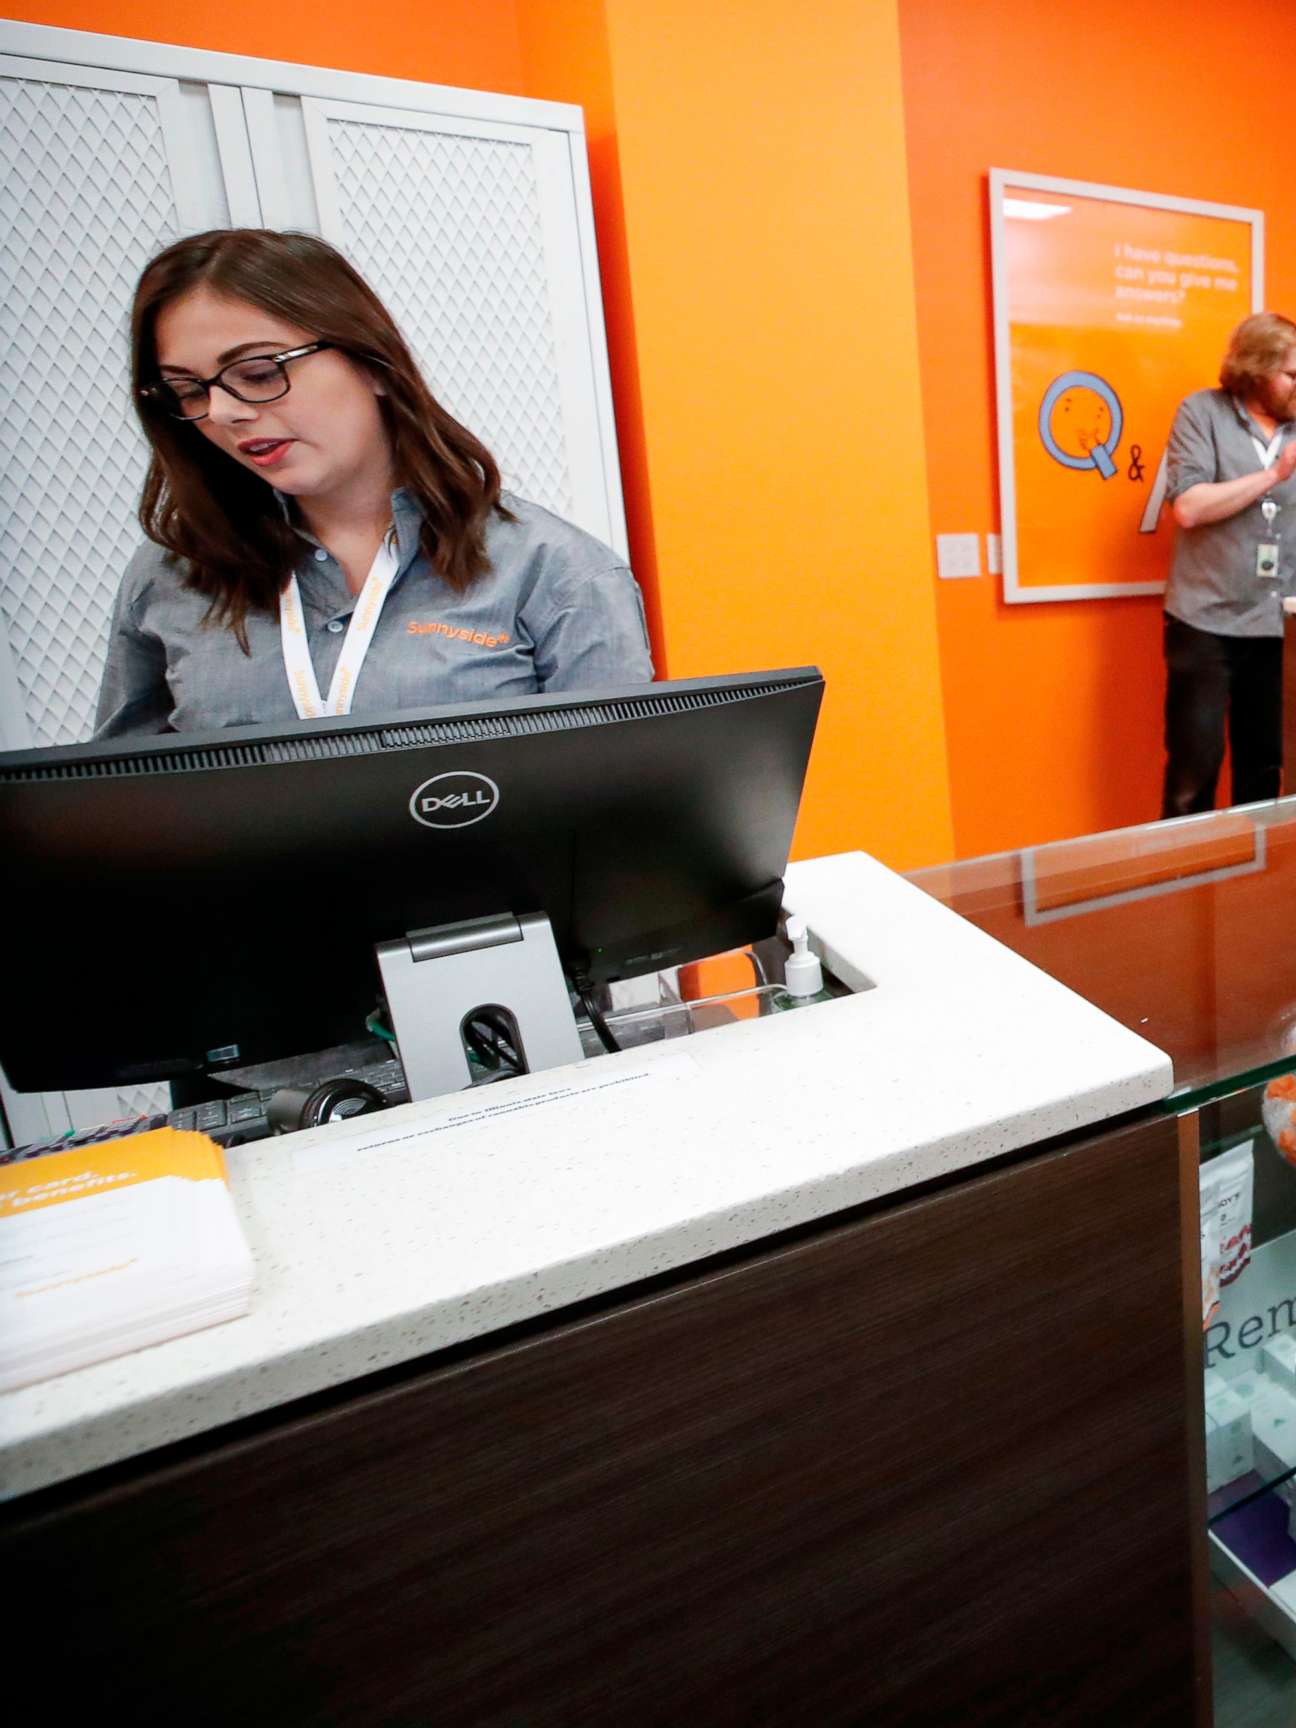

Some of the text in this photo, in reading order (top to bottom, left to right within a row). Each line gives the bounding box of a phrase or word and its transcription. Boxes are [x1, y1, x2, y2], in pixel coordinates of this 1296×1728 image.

[1148, 270, 1175, 285] you
[1039, 370, 1145, 482] Q &
[407, 622, 497, 648] Sunnyside
[421, 790, 491, 812] DELL
[357, 1138, 401, 1151] returns
[417, 1119, 471, 1136] exchanges
[487, 1102, 533, 1117] cannabis
[535, 1091, 579, 1105] products
[599, 1072, 649, 1089] prohibited
[484, 1099, 521, 1112] Illinois
[523, 1093, 546, 1103] state
